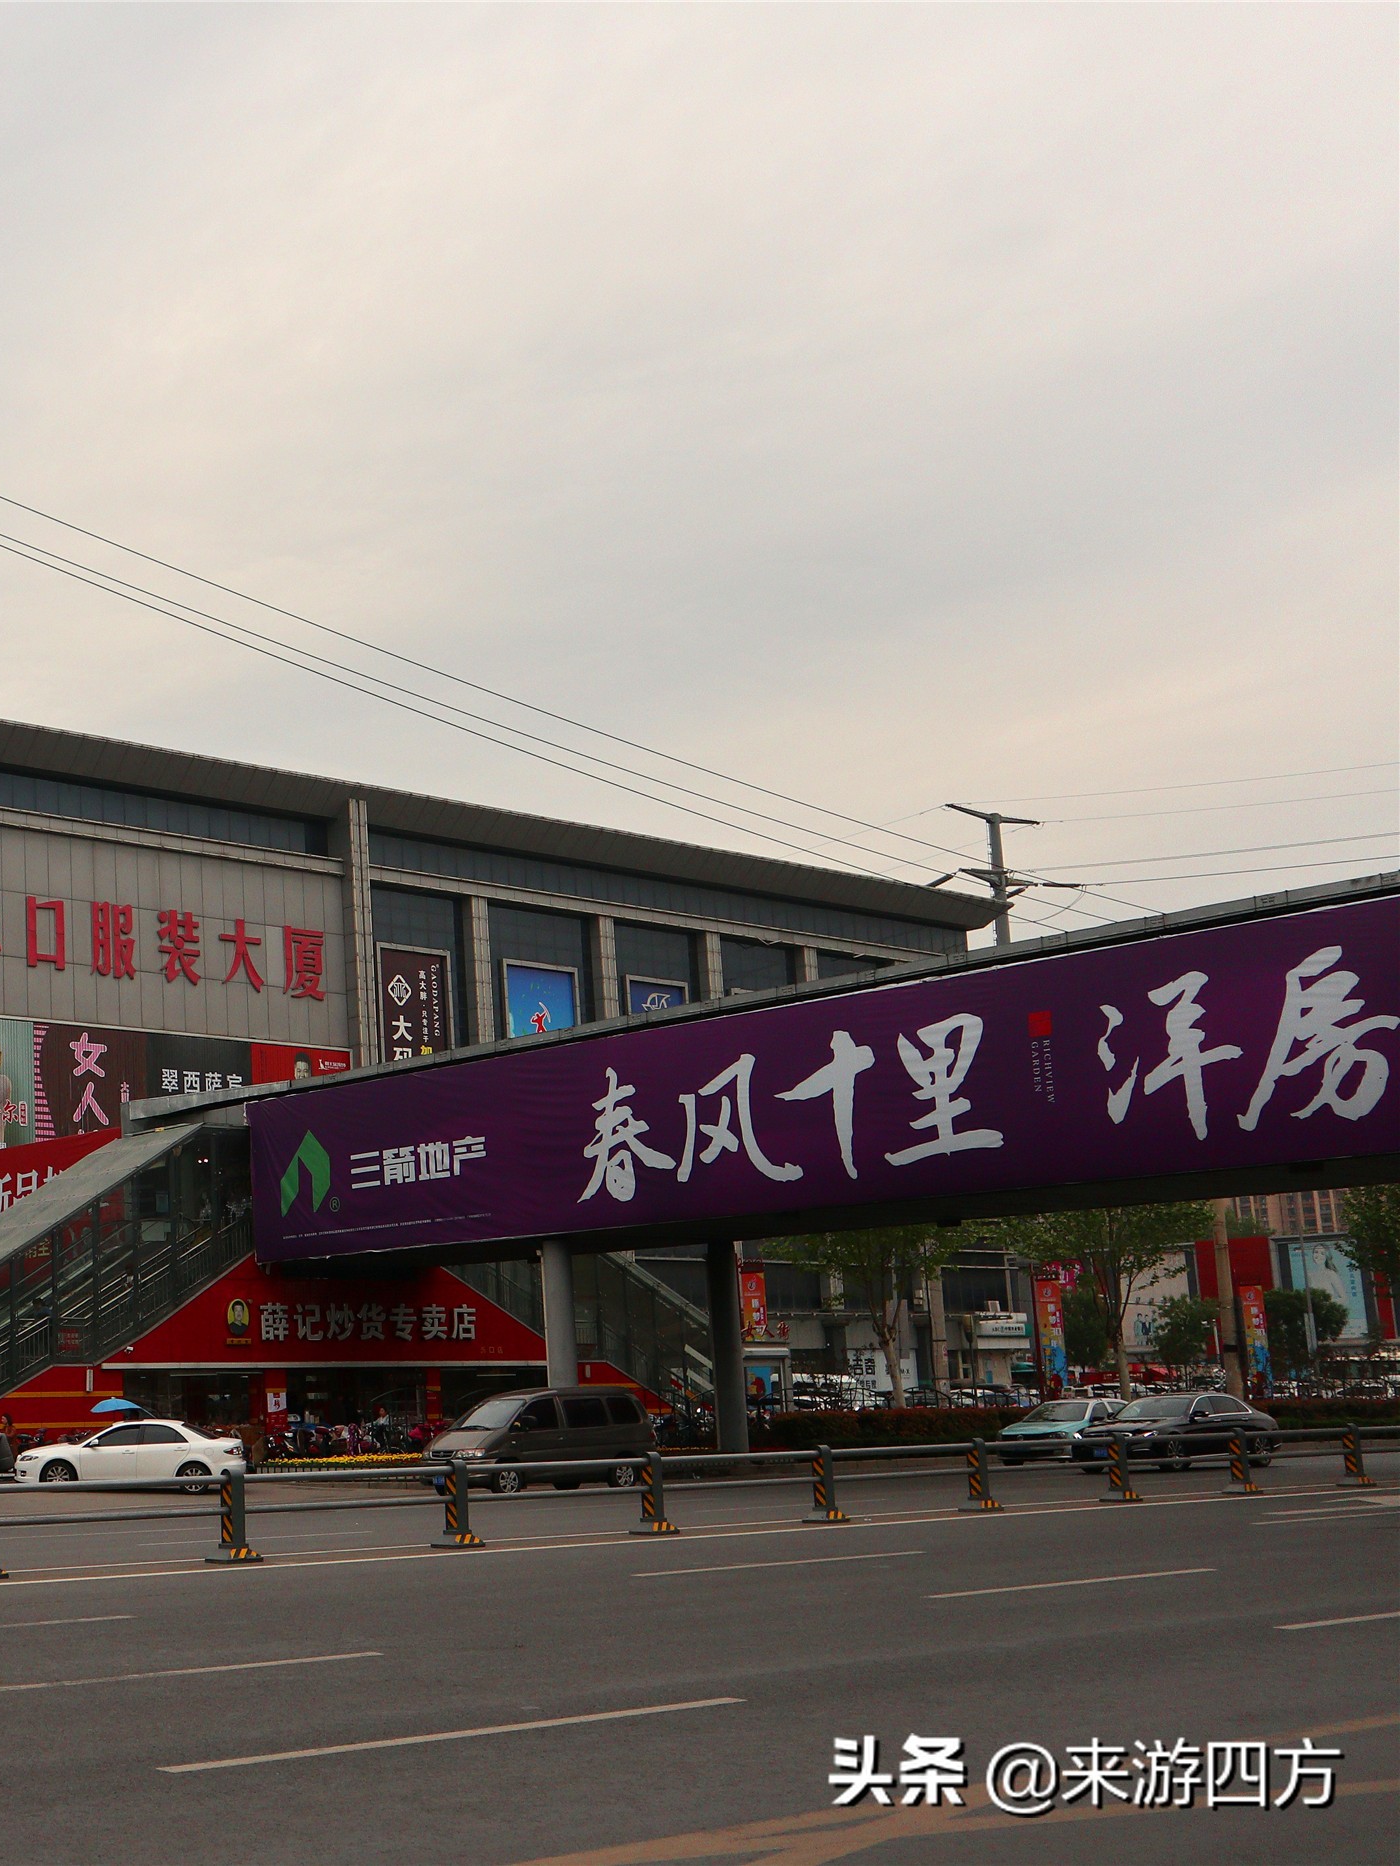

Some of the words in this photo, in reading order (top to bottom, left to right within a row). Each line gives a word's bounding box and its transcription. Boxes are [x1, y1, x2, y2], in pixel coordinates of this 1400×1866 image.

[1031, 1041, 1042, 1092] GARDEN
[1043, 1039, 1055, 1103] RICHVIEW
[1098, 945, 1399, 1141] 洋房
[69, 1031, 109, 1134] 女人
[576, 1013, 1005, 1204] 春风十里
[350, 1135, 487, 1190] 三箭地产
[259, 1302, 477, 1343] 薛记炒货专卖店
